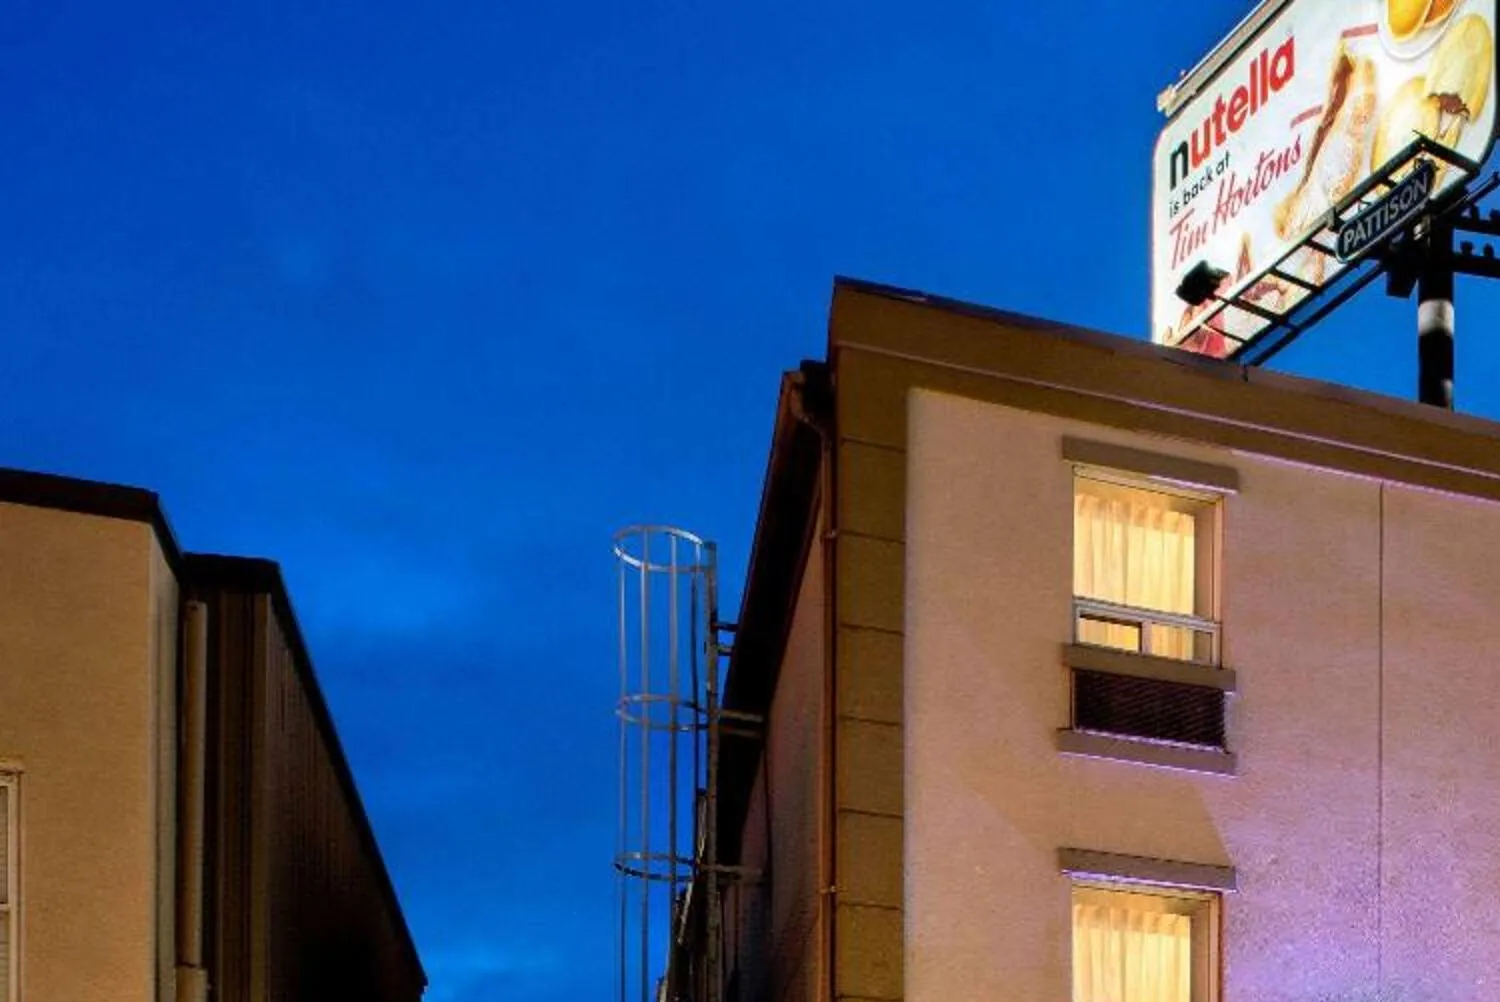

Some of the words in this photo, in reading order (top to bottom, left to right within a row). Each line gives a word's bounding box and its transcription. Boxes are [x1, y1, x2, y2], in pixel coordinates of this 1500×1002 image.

[1170, 34, 1296, 191] nutella
[1169, 200, 1180, 218] is
[1183, 168, 1214, 206] back
[1215, 150, 1231, 176] at
[1169, 207, 1209, 271] Tim
[1213, 134, 1302, 235] Hortons
[1341, 170, 1432, 254] PATTISON
